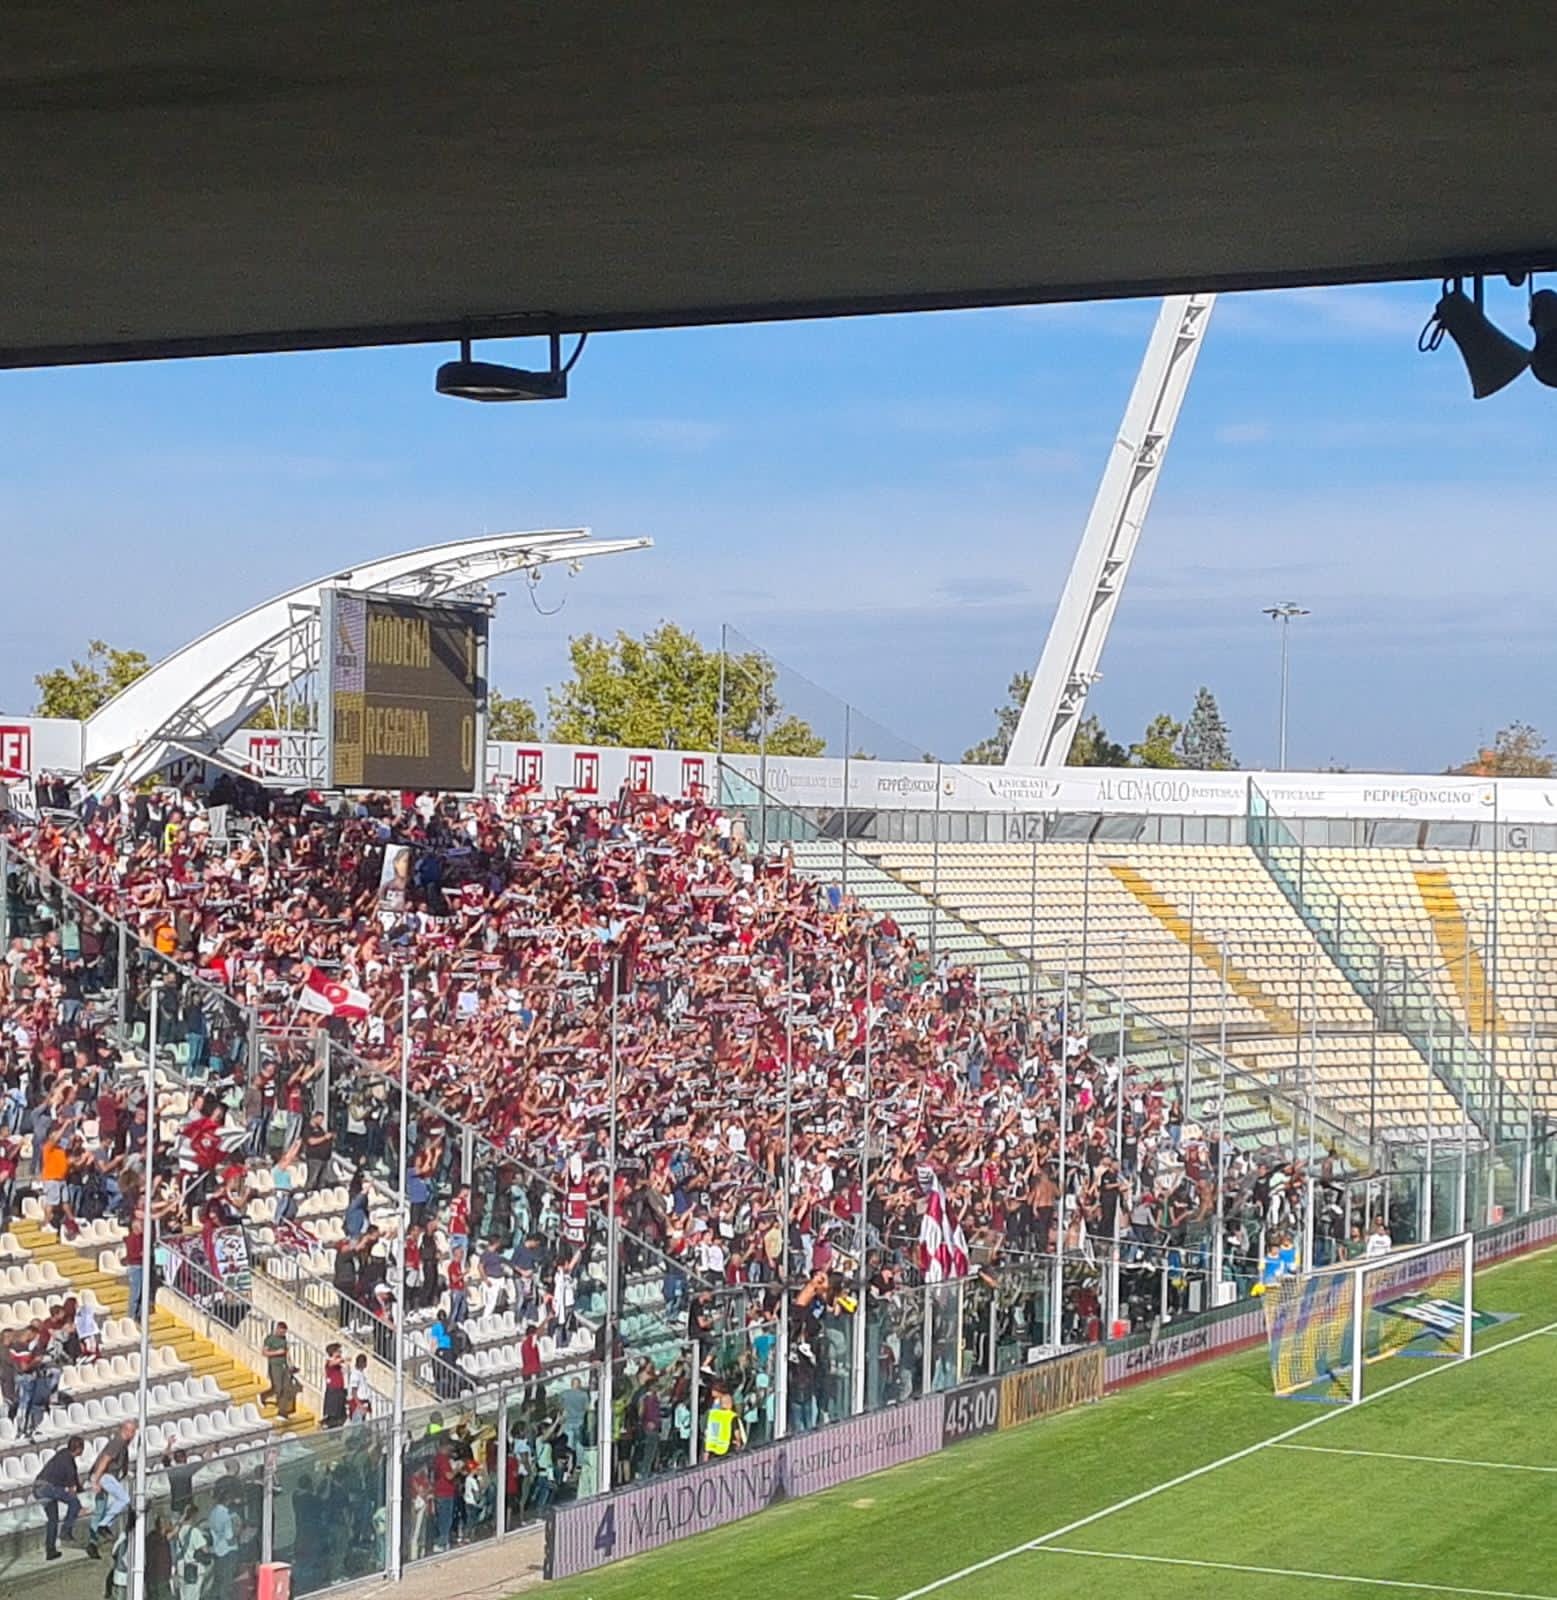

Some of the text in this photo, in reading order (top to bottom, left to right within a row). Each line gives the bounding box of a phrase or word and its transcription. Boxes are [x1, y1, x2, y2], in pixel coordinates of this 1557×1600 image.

[368, 615, 430, 668] MODENA
[366, 706, 473, 773] REGGINA 0
[1118, 779, 1190, 802] CENACOLO
[1363, 787, 1472, 806] PEPPERONCINO
[945, 1386, 998, 1436] 45:00
[594, 1504, 617, 1557] 4
[629, 1459, 774, 1545] MADONNE
